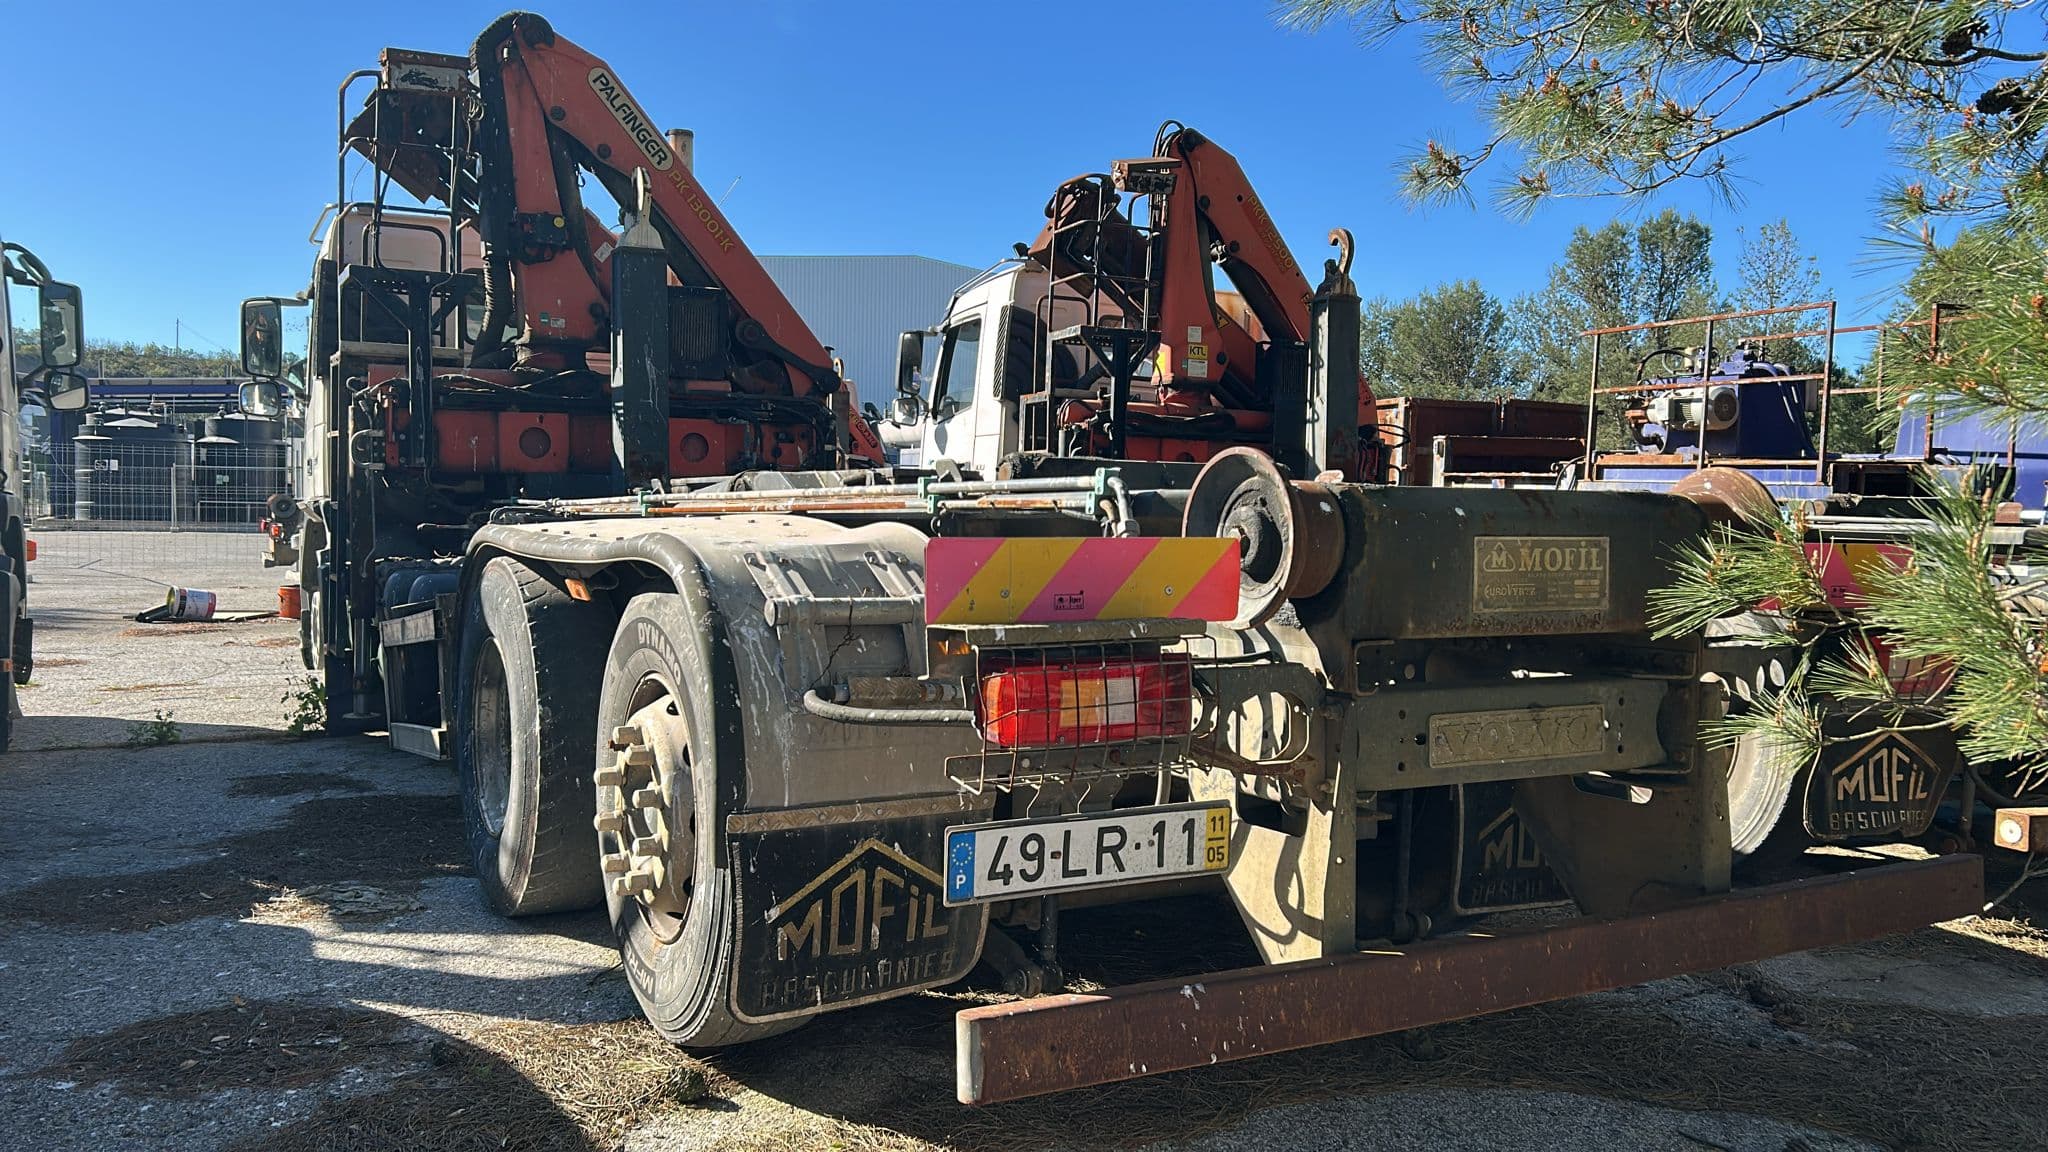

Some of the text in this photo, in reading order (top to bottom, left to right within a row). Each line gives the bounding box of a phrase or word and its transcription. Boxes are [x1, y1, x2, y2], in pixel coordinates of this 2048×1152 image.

[592, 73, 669, 165] PALFINGER
[667, 170, 690, 194] PK
[1189, 345, 1206, 356] KTL
[637, 622, 681, 686] DYNAMO
[1436, 714, 1592, 757] VOLVO
[1210, 815, 1225, 833] 11
[1206, 845, 1225, 863] 05
[955, 873, 967, 890] P
